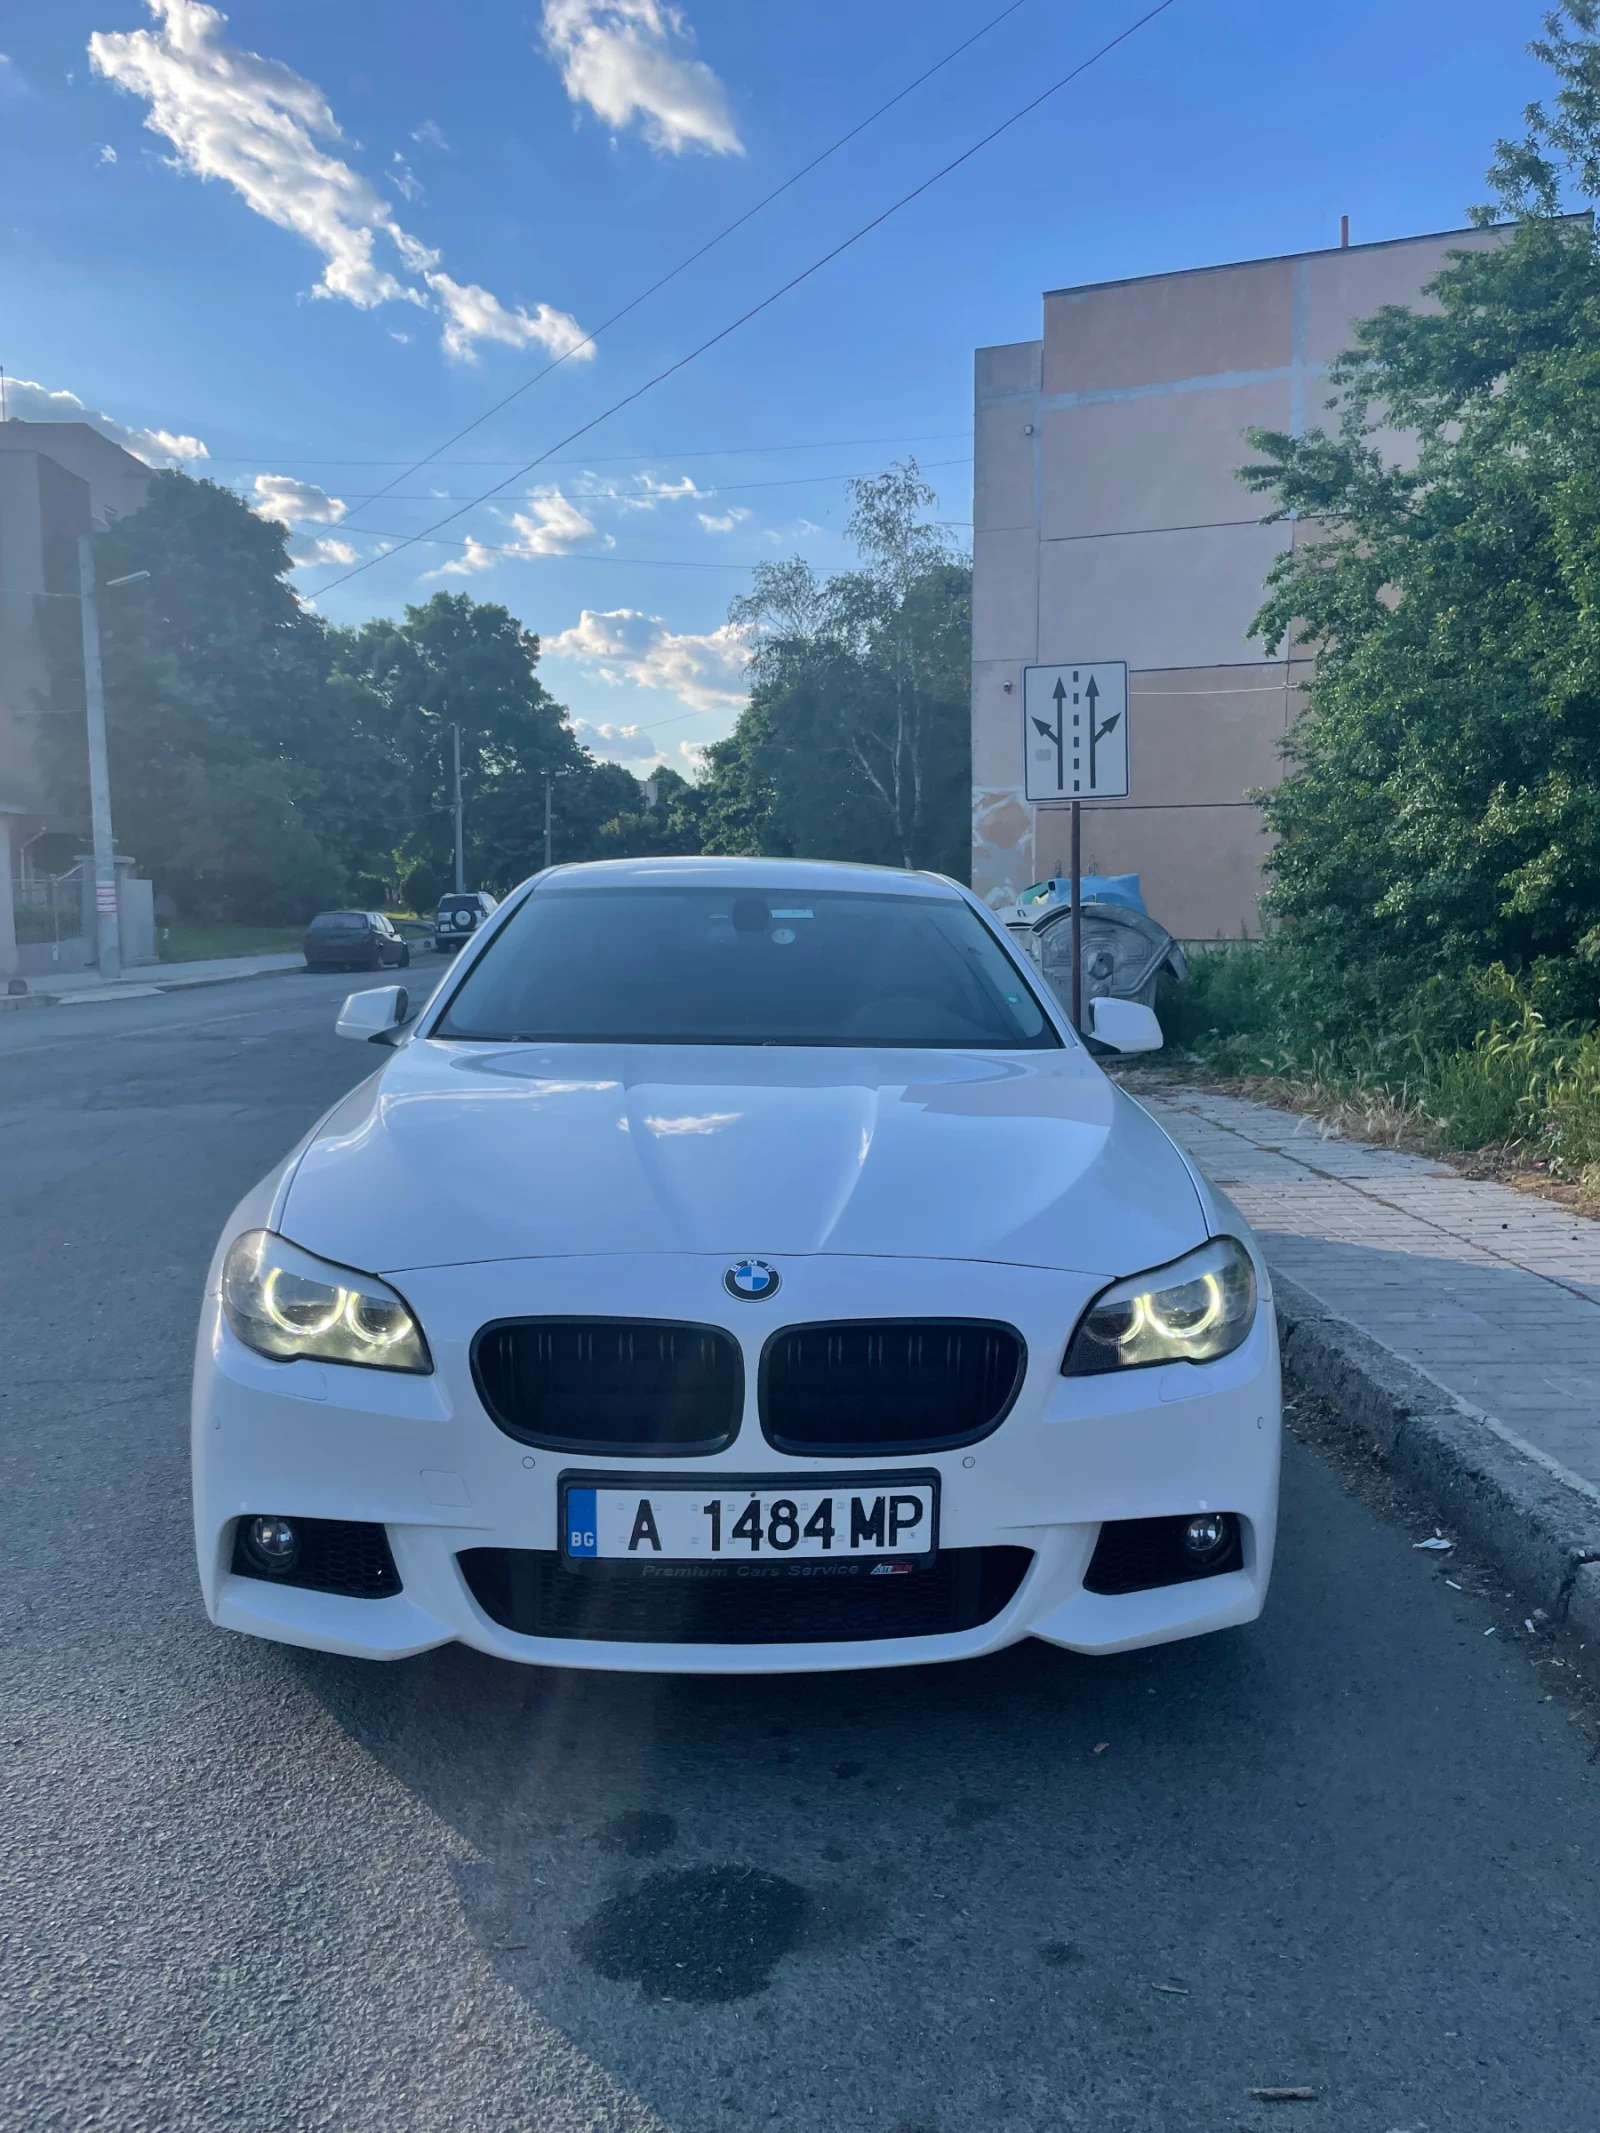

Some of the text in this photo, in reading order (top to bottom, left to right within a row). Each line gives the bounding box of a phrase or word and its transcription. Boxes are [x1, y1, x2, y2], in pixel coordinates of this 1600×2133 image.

[731, 1260, 776, 1273] BMW
[628, 1494, 924, 1551] A 1484 MP
[571, 1531, 595, 1547] BG
[641, 1564, 860, 1577] Premium Cars Service
